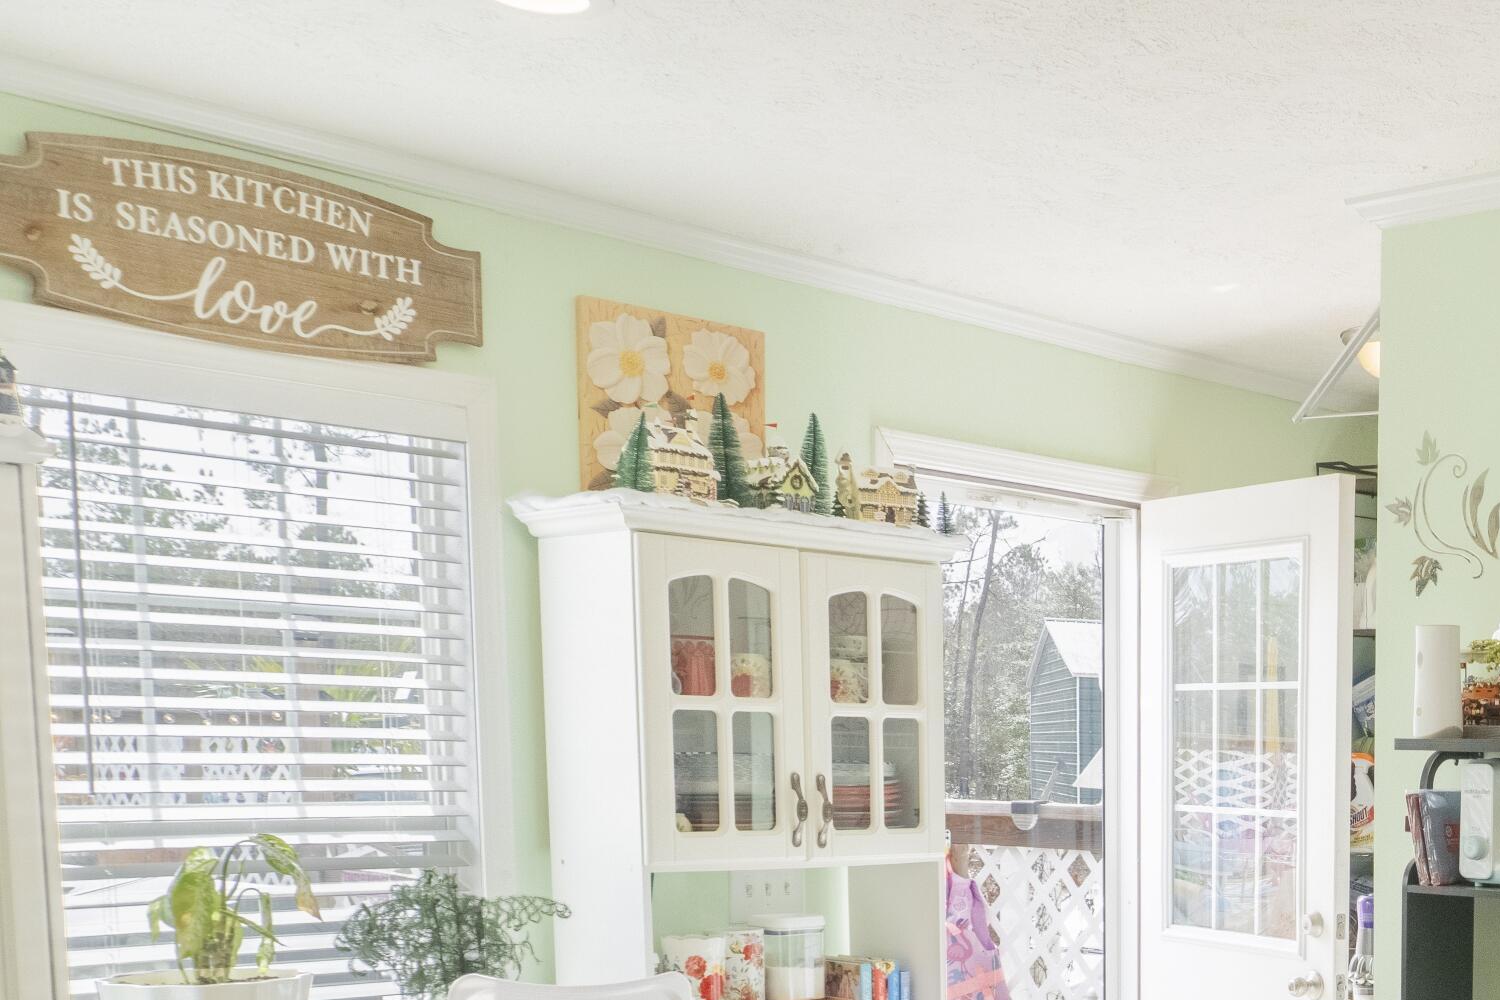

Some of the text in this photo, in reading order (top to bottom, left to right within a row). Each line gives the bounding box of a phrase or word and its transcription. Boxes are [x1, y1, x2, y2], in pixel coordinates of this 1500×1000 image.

[56, 189, 422, 286] IS SEASONED WITH
[103, 156, 373, 238] THIS KITCHEN
[193, 256, 326, 338] love
